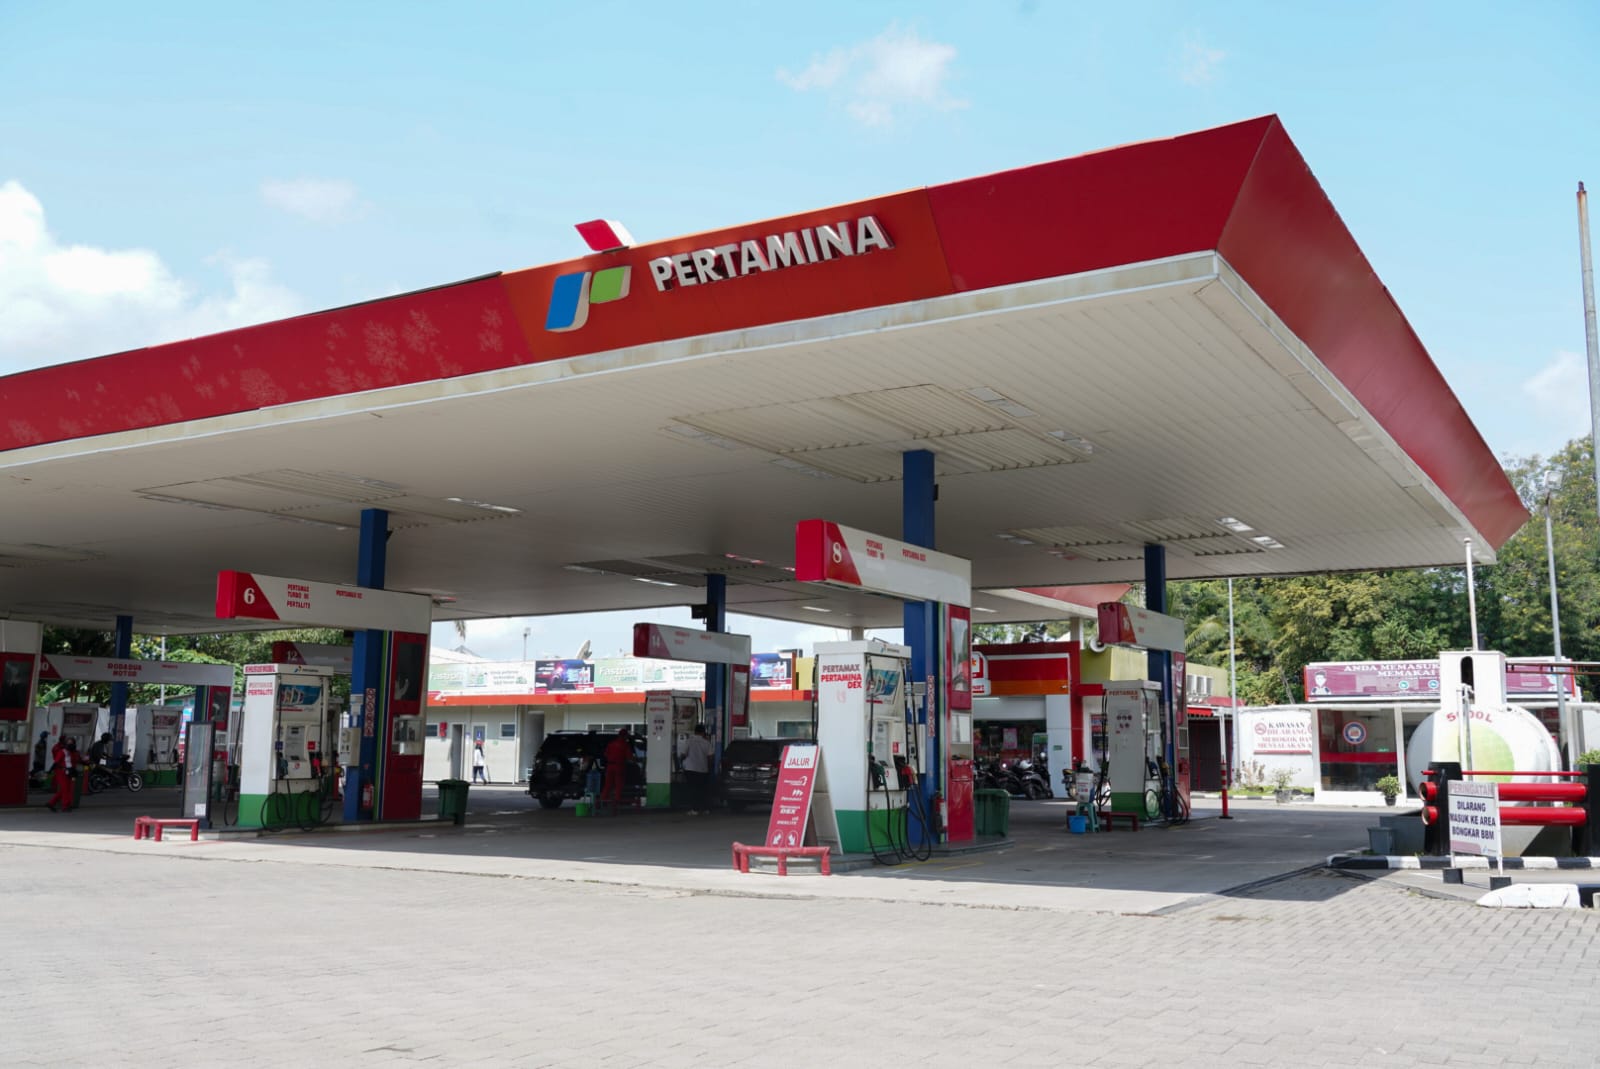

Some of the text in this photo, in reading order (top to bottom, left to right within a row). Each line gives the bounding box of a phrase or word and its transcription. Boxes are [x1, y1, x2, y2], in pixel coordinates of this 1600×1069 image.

[649, 215, 894, 292] PERTAMINA
[832, 541, 842, 563] 8
[243, 587, 256, 605] 6
[286, 601, 311, 609] PERTALITE
[822, 664, 860, 673] PERTAMAX
[1344, 664, 1377, 672] ANDA
[821, 674, 862, 682] PERTAMINA
[847, 681, 862, 689] DEX
[787, 757, 810, 767] JALUR
[1456, 801, 1486, 812] DILARANG
[1470, 815, 1478, 825] KE
[1479, 816, 1496, 827] AREA
[1452, 826, 1495, 840] BONGKAR BBM
